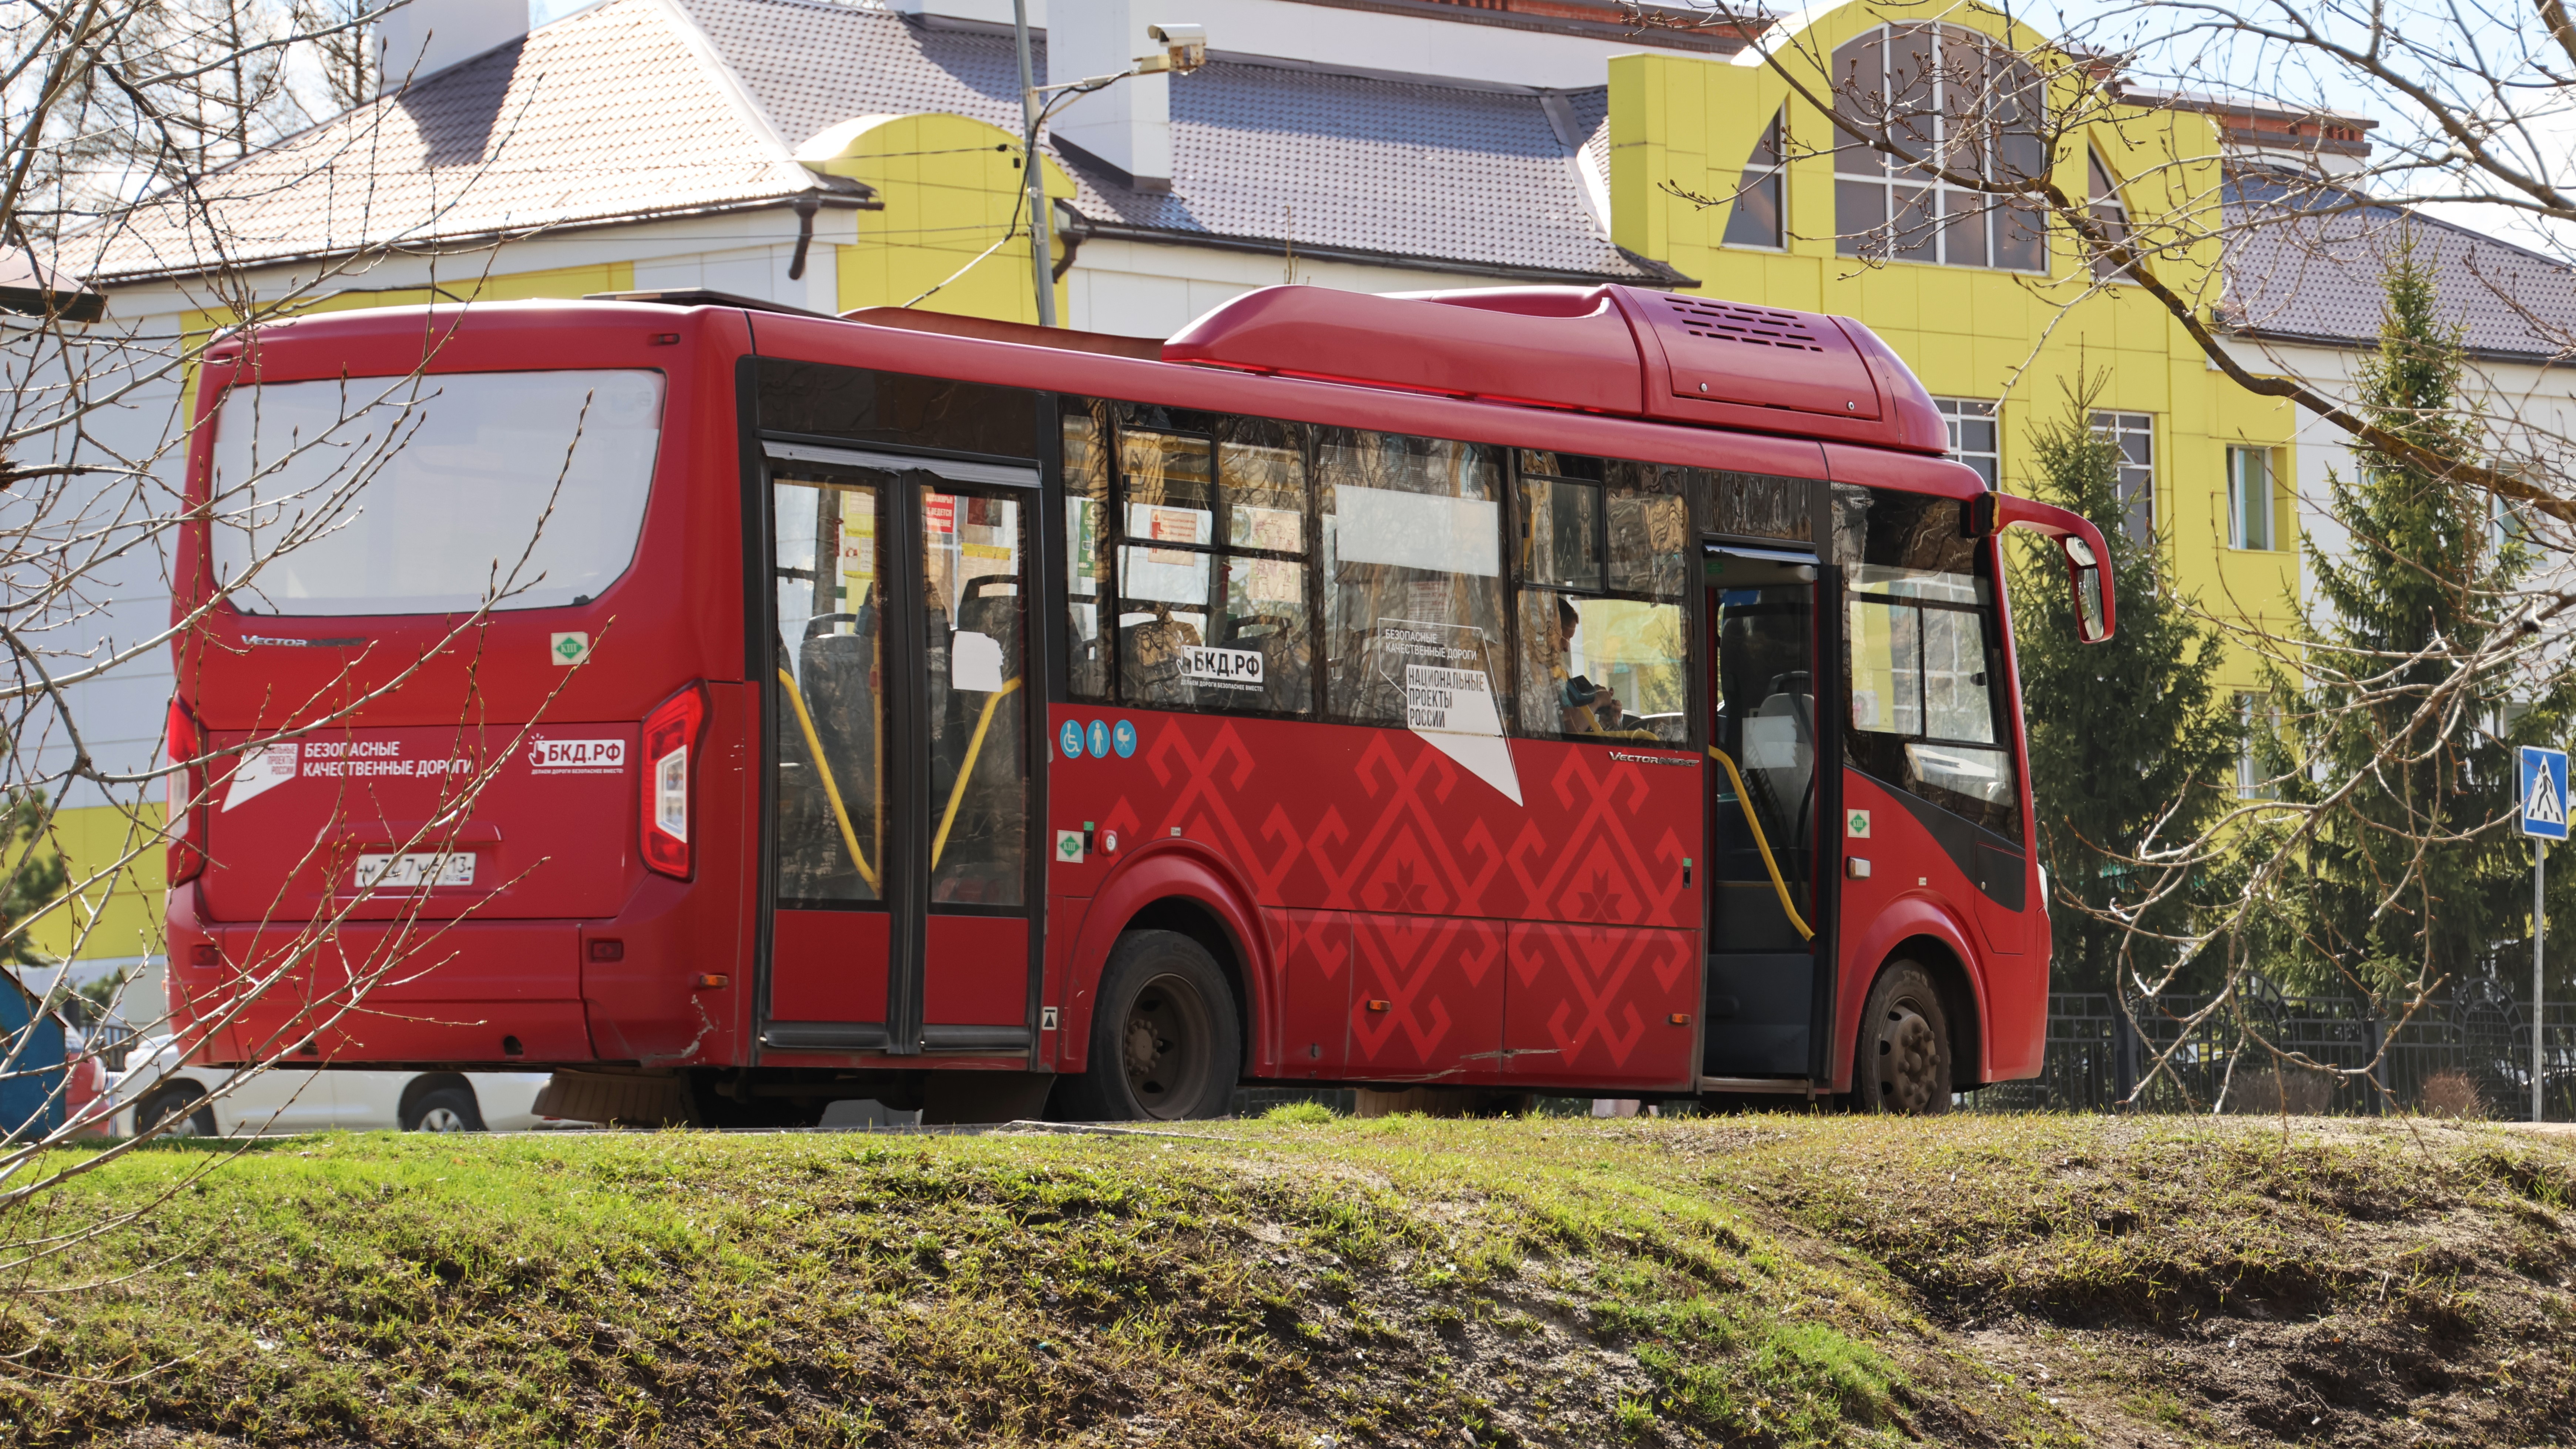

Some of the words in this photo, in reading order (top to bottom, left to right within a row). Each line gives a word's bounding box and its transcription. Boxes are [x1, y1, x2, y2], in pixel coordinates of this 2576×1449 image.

[1385, 629, 1437, 644] БЕЗОПАСНЫЕ
[1386, 643, 1446, 658] КАЧЕСТВЕННЫЕ
[1447, 648, 1477, 661] ДОРОГИ
[1194, 651, 1259, 677] БКД.РФ
[1408, 668, 1485, 692] НАЦИОНАЛЬНЫЕ
[1409, 688, 1452, 709] ПРОЕКТЫ
[1409, 708, 1445, 728] РОССИИ
[305, 741, 400, 758] БЕЗОПАСНЫЕ
[549, 743, 621, 764] БКД.РФ
[267, 755, 295, 765] ПРОЕКТЫ
[303, 761, 414, 777] КАЧЕСТВЕННЫЕ
[416, 759, 474, 778] ДОРОГИ
[1853, 819, 1864, 828] КПГ
[1063, 842, 1076, 851] КПГ
